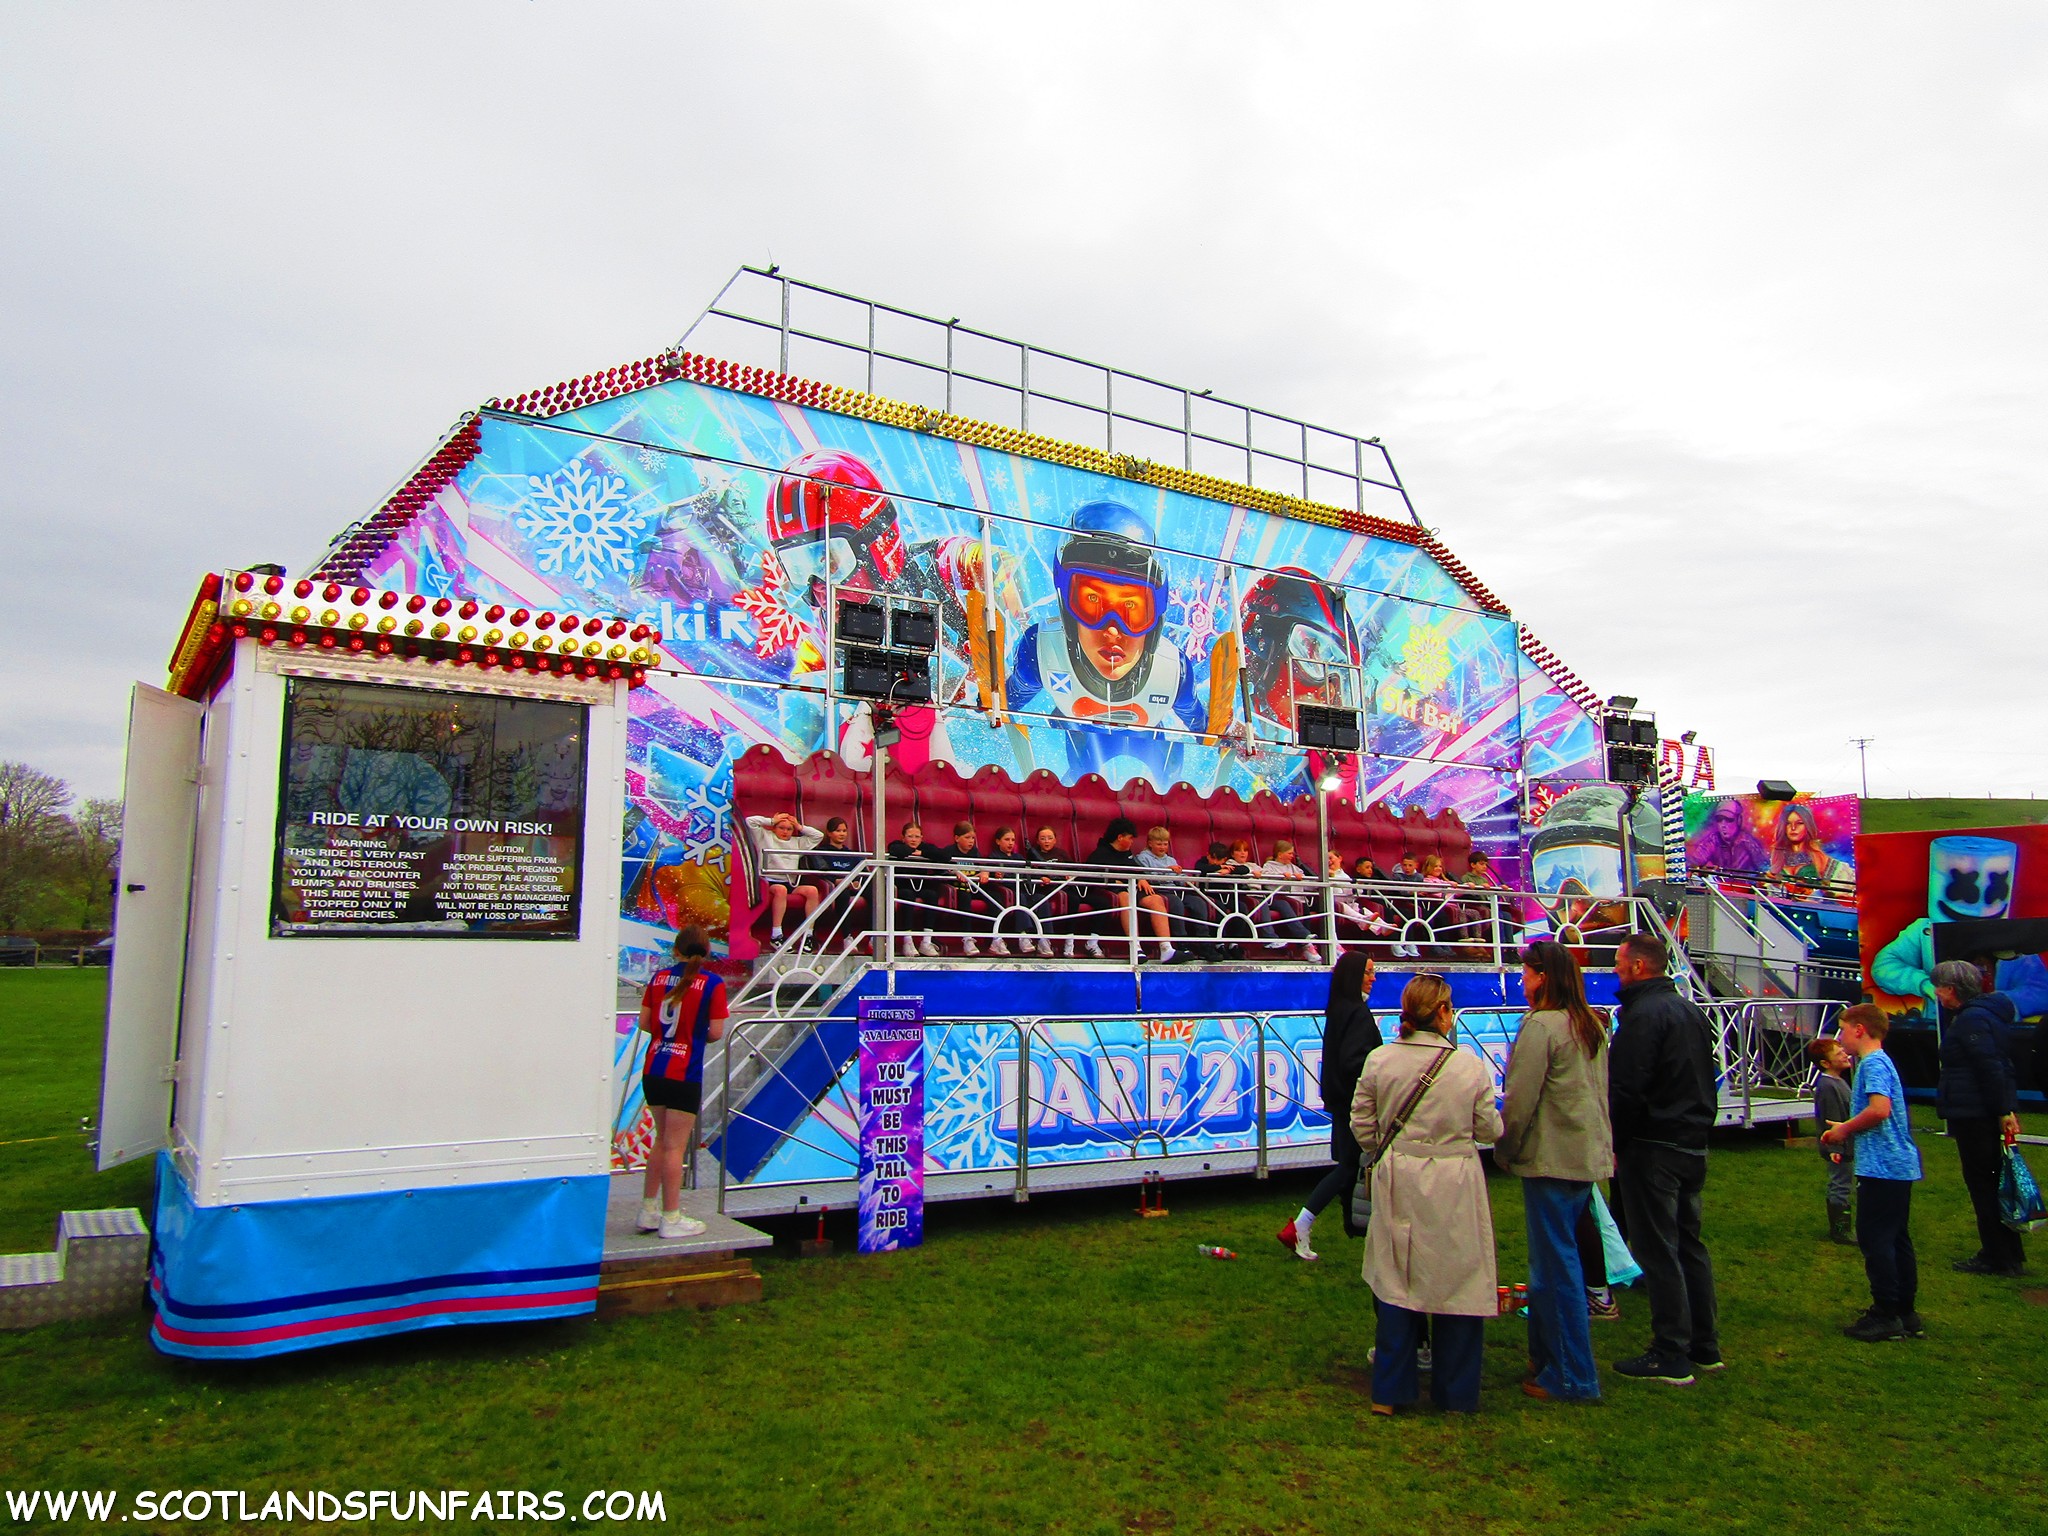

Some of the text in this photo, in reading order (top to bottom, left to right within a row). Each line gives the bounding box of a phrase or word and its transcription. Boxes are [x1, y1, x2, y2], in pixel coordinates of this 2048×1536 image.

[1424, 703, 1461, 734] Bar
[312, 812, 553, 835] RIDE AT YOUR OWN RISK!
[332, 840, 387, 848] WARNING
[488, 845, 524, 853] CAUTION
[288, 848, 315, 856] THIS
[319, 849, 347, 857] RIDE
[333, 860, 411, 869] BOISTEROUS.
[453, 854, 557, 864] PEOPLE SUFFERING FROM
[469, 864, 515, 873] PROBLEMS,
[517, 865, 565, 873] PREGNANCY
[348, 870, 421, 879] ENCOUNTER
[291, 879, 419, 890] BUMPS AND BRUISES.
[476, 883, 497, 891] RIDE.
[301, 889, 328, 897] THIS
[332, 890, 360, 898] RIDE
[395, 891, 410, 899] BE
[303, 899, 359, 908] STOPPED
[395, 901, 406, 909] IN
[514, 903, 568, 911] RESPONSIBLE
[310, 910, 398, 919] EMERGENCIES.
[653, 975, 705, 990] LEWANDSKI
[659, 996, 682, 1038] 9
[868, 1009, 915, 1020] HICKEY'S
[863, 1029, 921, 1042] AVALANCH
[877, 1063, 906, 1081] YOU
[997, 1053, 1185, 1131] DARE
[1198, 1049, 1241, 1118] 2
[872, 1087, 911, 1106] MUST
[882, 1112, 901, 1130] BE
[875, 1137, 907, 1154] THIS
[875, 1161, 908, 1179] TALL
[882, 1186, 900, 1203] TO
[875, 1209, 907, 1229] RIDE
